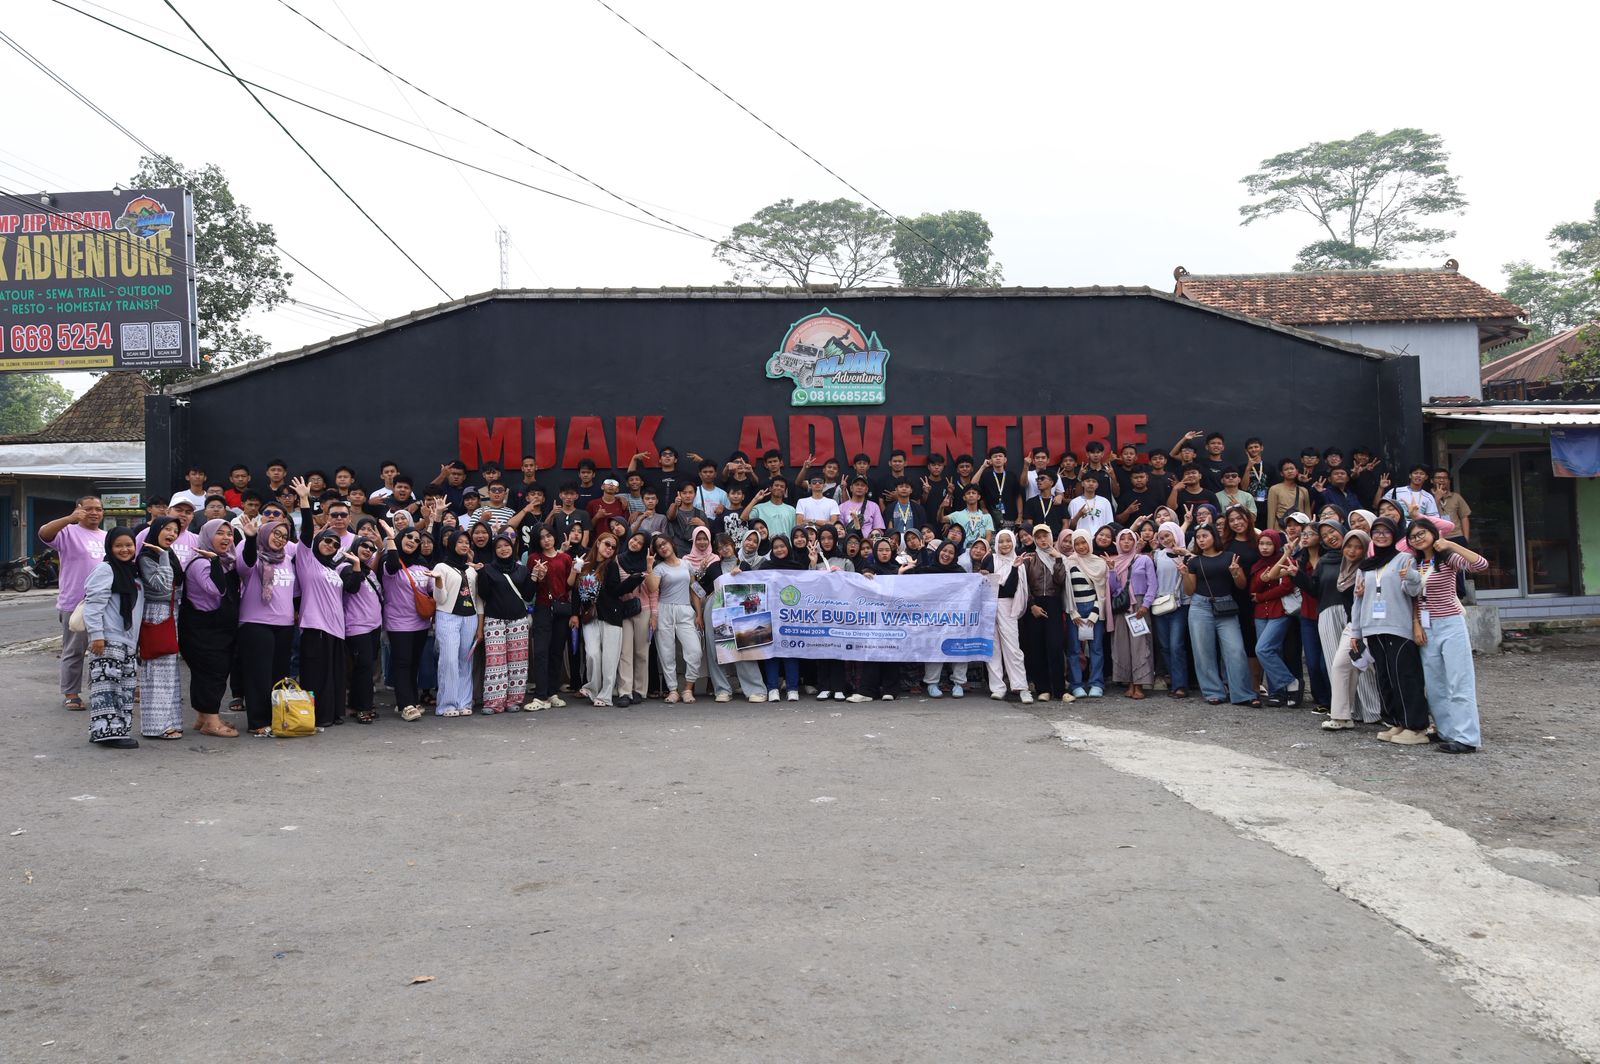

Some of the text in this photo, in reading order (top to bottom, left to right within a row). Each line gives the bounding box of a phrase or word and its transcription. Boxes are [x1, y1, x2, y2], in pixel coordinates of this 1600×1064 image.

[22, 213, 47, 233] JIP
[48, 211, 112, 232] WISATA
[15, 230, 173, 281] ADVENTURE
[46, 288, 74, 300] SEWA
[77, 287, 106, 298] TRAIL
[117, 285, 173, 296] OUTBOND
[12, 303, 45, 315] RESTO
[57, 301, 113, 313] HOMESTAY
[116, 299, 160, 311] TRANSIT
[11, 323, 53, 352] 668
[57, 321, 113, 350] 5254
[831, 371, 882, 384] Adventure
[809, 390, 883, 401] 0816685254
[458, 414, 1149, 471] MJAK ADVENTURE
[779, 608, 980, 627] SMK BUDHI WARMAN II
